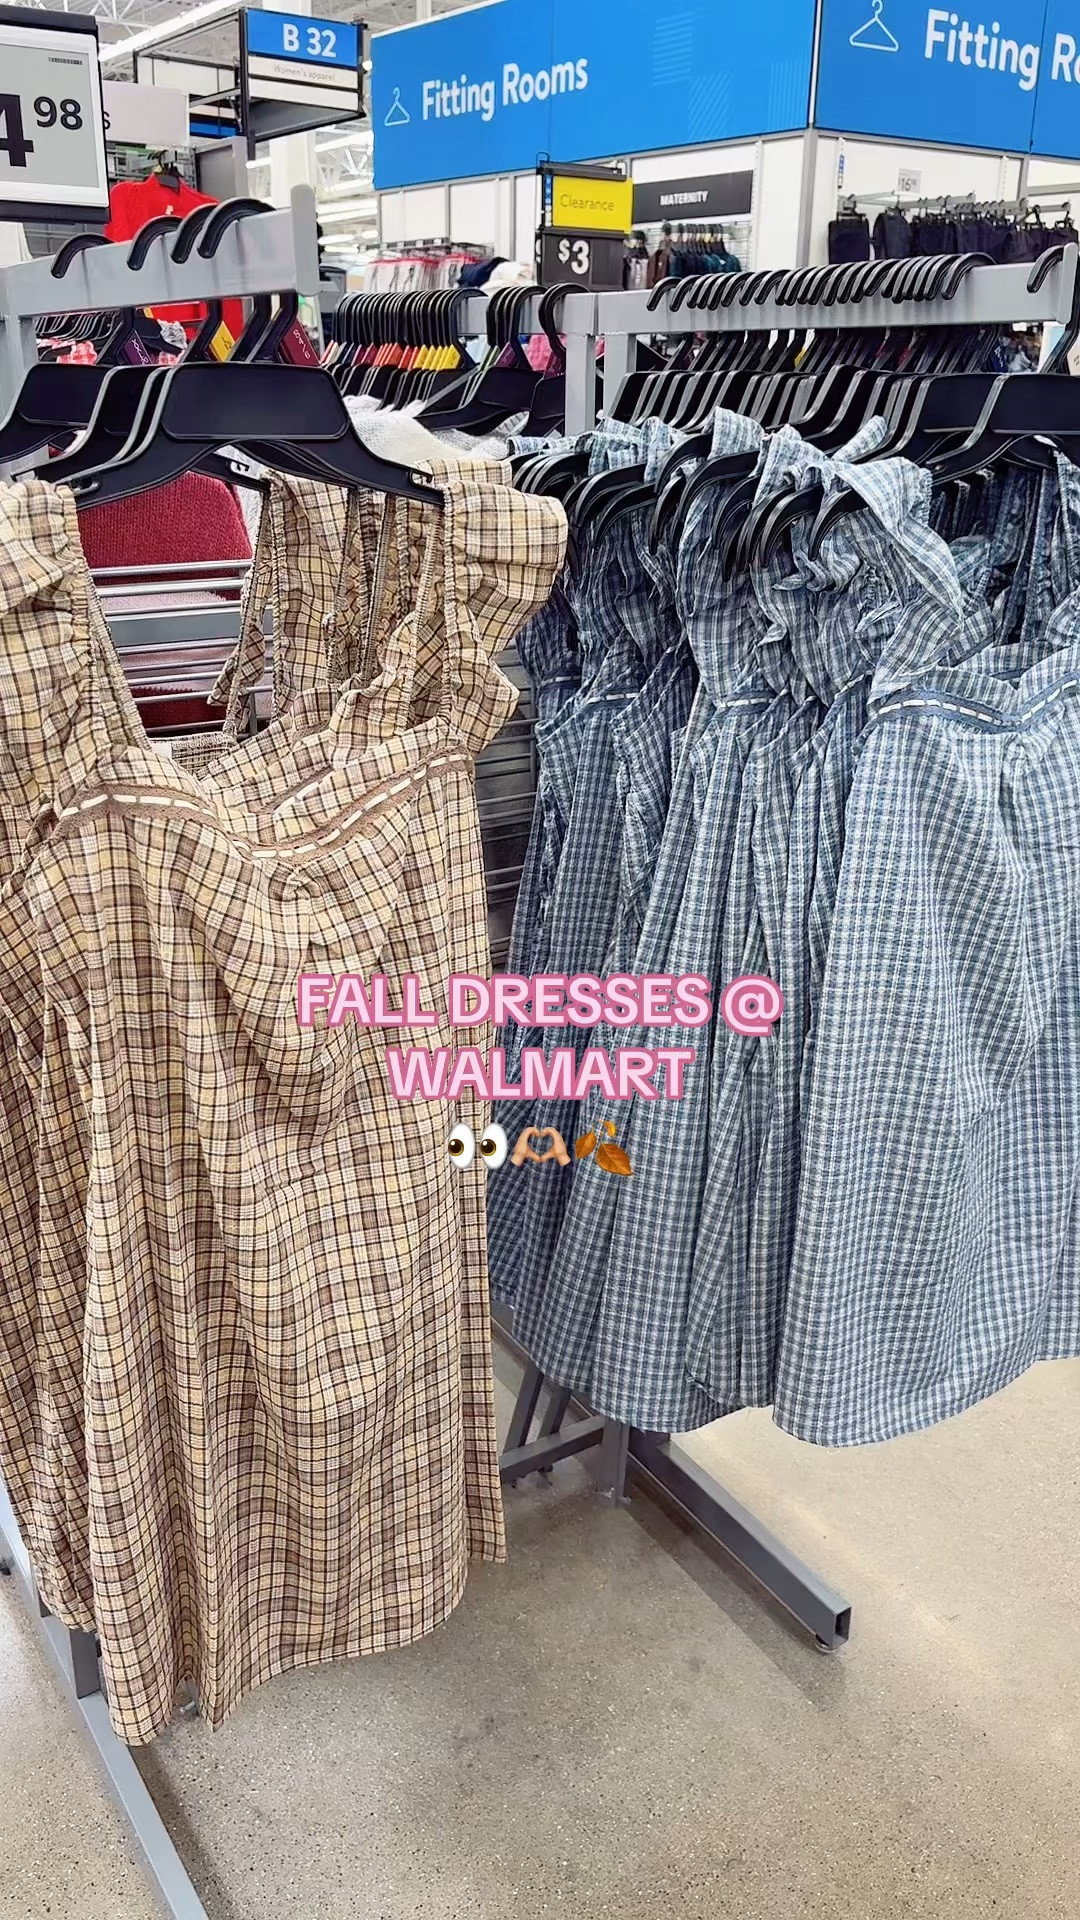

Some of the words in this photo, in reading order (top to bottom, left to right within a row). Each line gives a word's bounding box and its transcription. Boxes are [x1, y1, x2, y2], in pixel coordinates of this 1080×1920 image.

[283, 23, 300, 52] B
[306, 27, 337, 58] 32
[924, 8, 1040, 92] Fitting
[423, 73, 495, 122] Fitting
[503, 57, 588, 106] Rooms
[560, 194, 615, 212] Clearance
[660, 190, 709, 206] MATERNITY
[558, 238, 590, 275] $3
